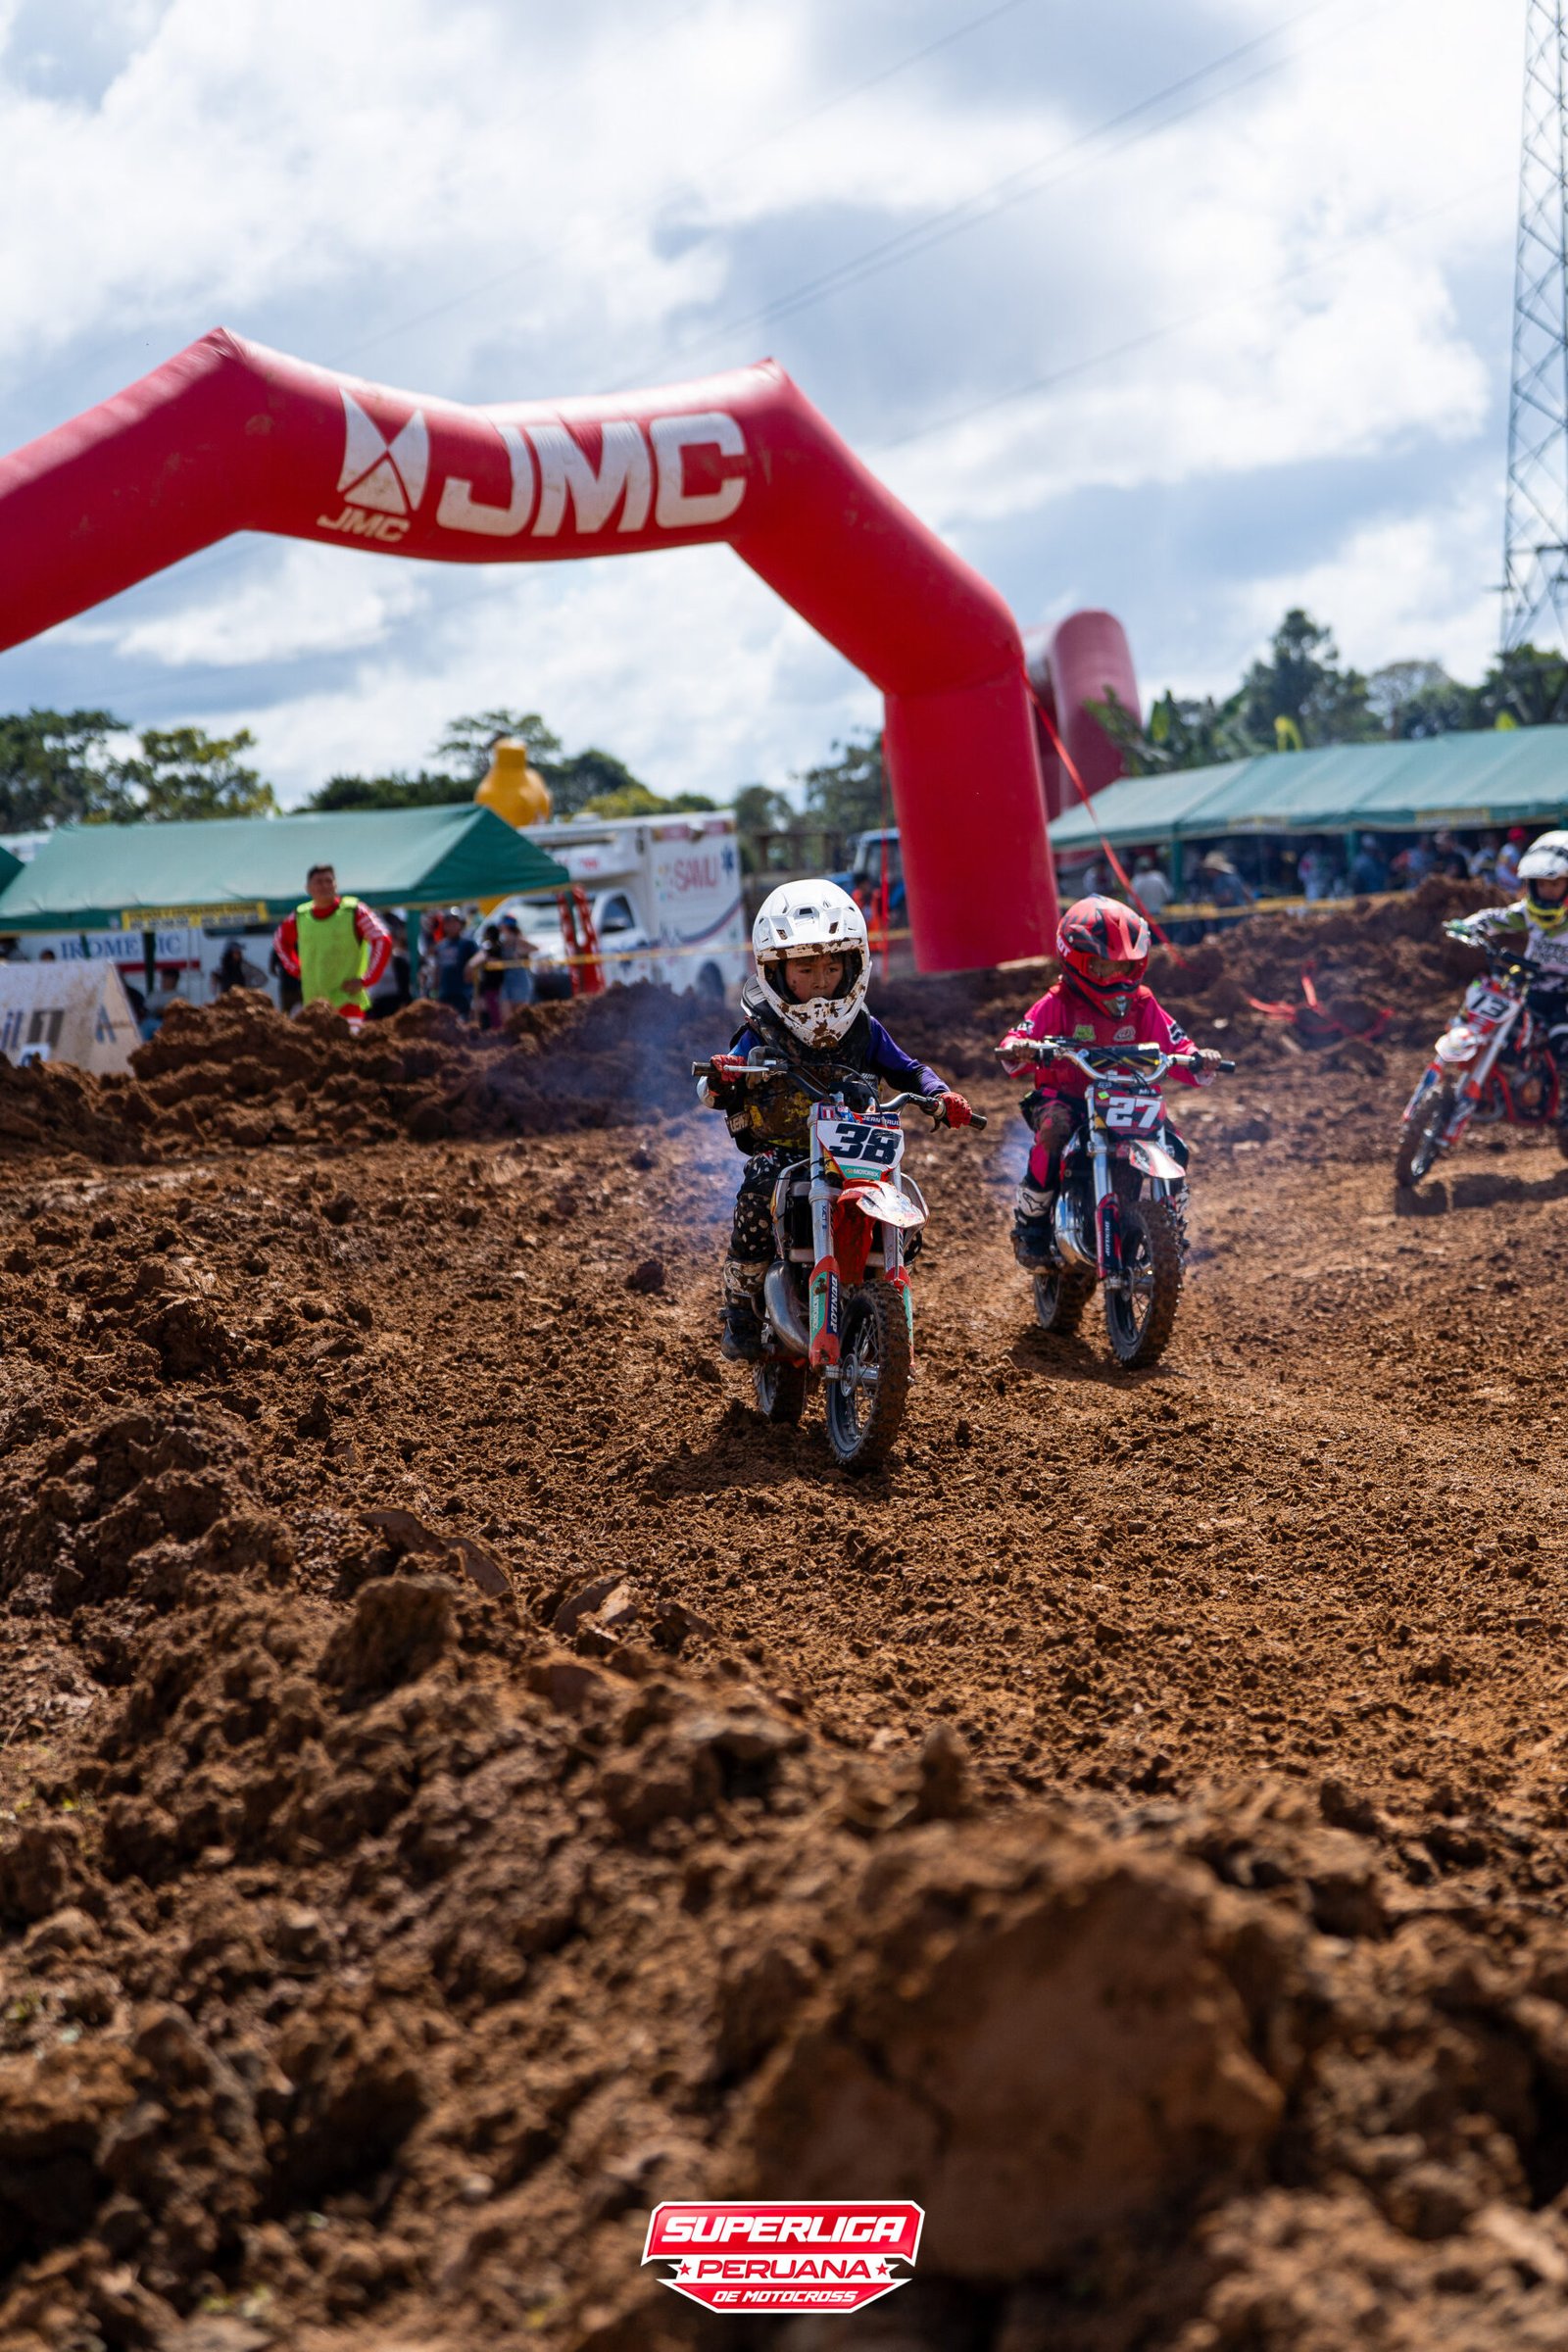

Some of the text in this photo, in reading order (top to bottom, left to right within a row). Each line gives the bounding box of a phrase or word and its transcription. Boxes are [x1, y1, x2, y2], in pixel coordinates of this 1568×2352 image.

[436, 413, 747, 537] JMC
[316, 506, 411, 543] JMC
[1471, 993, 1510, 1018] 13
[1105, 1097, 1160, 1128] 27
[829, 1123, 903, 1164] 38
[853, 1168, 879, 1177] MOTOREX
